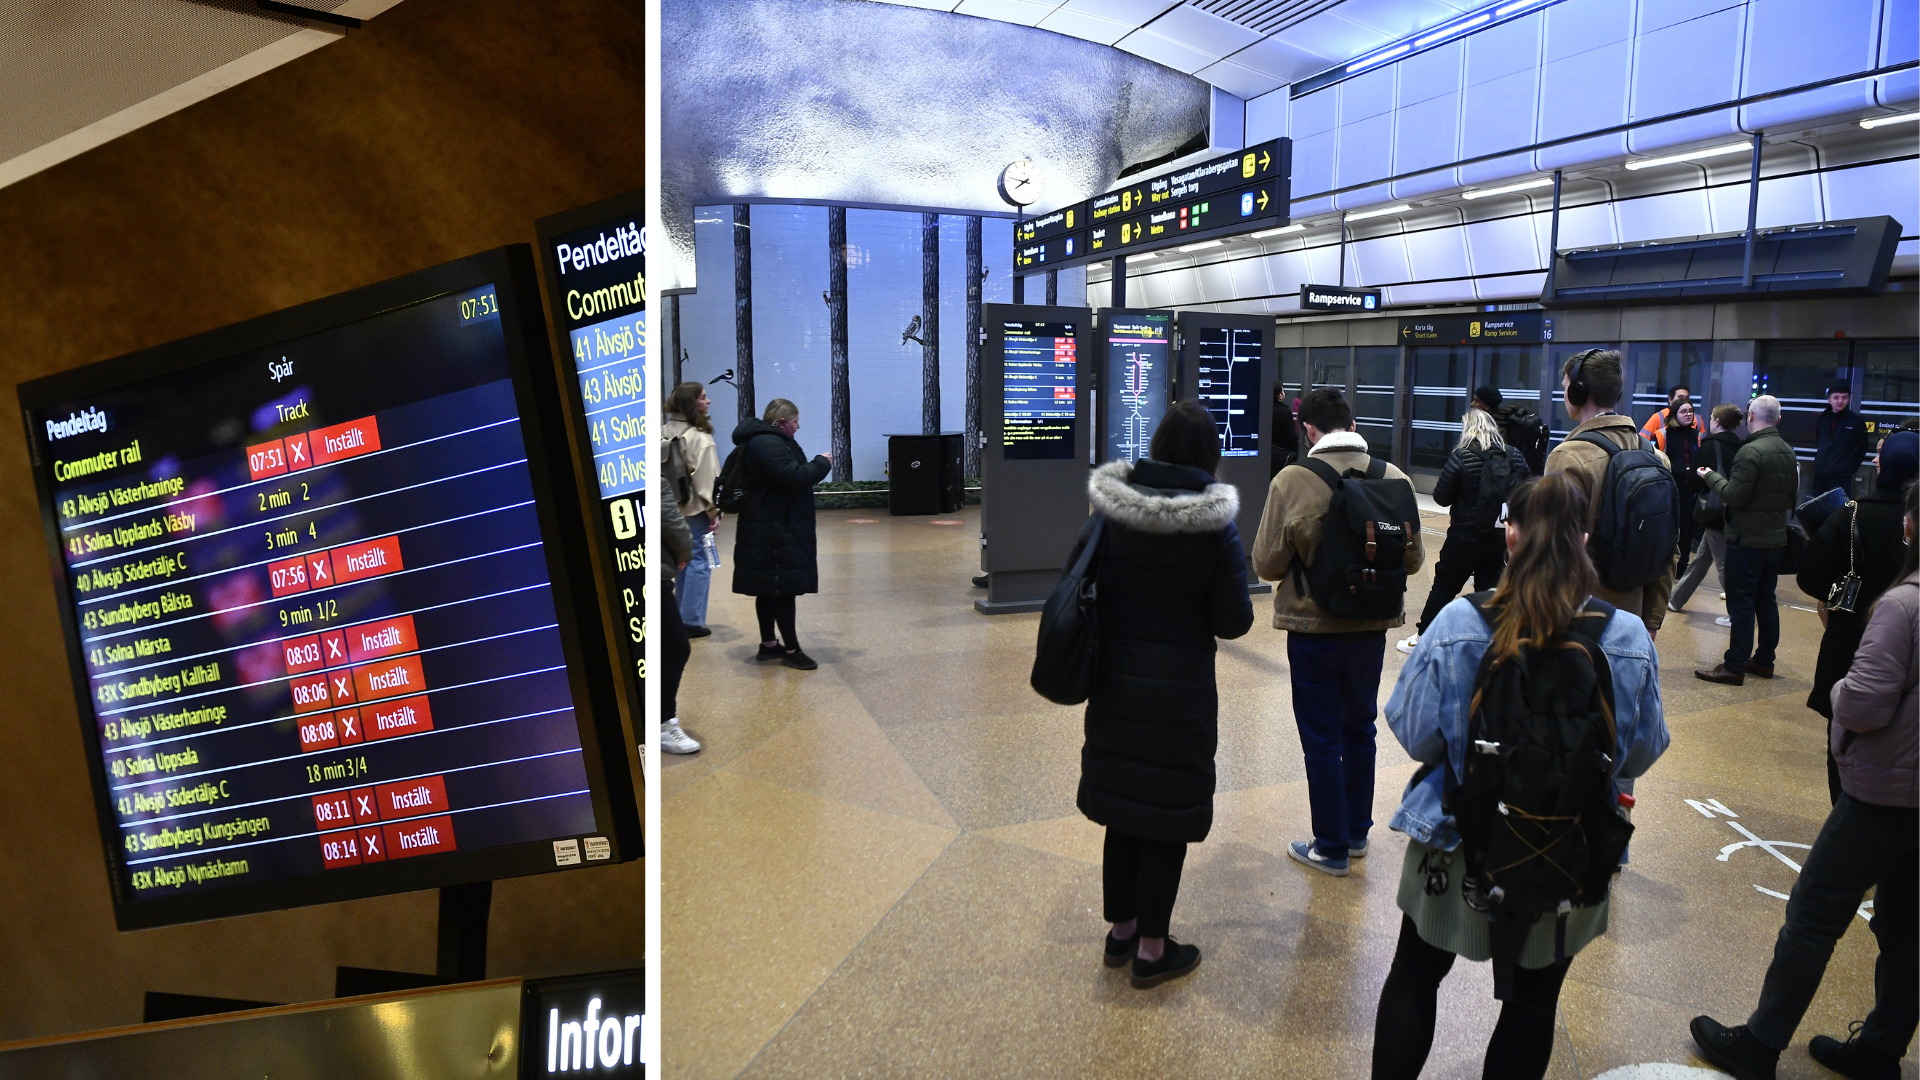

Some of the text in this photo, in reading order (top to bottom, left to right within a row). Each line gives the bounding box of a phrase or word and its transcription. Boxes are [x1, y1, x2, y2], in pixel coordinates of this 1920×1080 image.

[460, 293, 498, 320] 07:51
[567, 271, 646, 320] Commut
[1309, 291, 1362, 306] Rampservice
[1484, 321, 1514, 329] Rampservice
[1543, 329, 1552, 340] 16
[576, 335, 592, 363] 41
[594, 326, 634, 358] Älvsjö
[268, 356, 294, 382] Spår
[584, 368, 642, 404] 43 Älvsjö
[46, 406, 107, 441] Pendeltåg
[275, 399, 309, 423] Track
[592, 413, 646, 446] 41 Solna
[54, 439, 142, 482] Commuter rail
[250, 428, 365, 472] 07:51 X Inställt
[600, 460, 618, 488] 40
[62, 476, 184, 519] 43 Älvsjö Västerhaninge
[258, 483, 310, 512] 2 min 2
[69, 511, 196, 556] 41 Solna Upplands Väsby
[265, 521, 317, 550] 3 min 4
[76, 552, 187, 593] 40 Älvsjö Södertälje C
[272, 547, 387, 589] 07:56 X Inställt
[615, 543, 646, 572] Inst
[83, 592, 193, 630] 43 Sundbyberg Bålsta
[279, 599, 338, 627] 9 min 1/2
[90, 637, 172, 667] 41 Solna Märsta
[286, 626, 402, 666] 08:03 X Inställt
[97, 662, 221, 704] 43X Sundbyberg Kallhäll
[293, 666, 410, 705] 08:06 X Inställt
[104, 705, 227, 741] 43 Älvsjö Västerhaninge
[301, 706, 417, 744] 08:08 X Inställt
[111, 746, 199, 779] 40 Solna Uppsala
[306, 756, 368, 784] 18 min 3/4
[118, 780, 230, 816] 41 Älvsjö Södertälje C
[316, 786, 432, 822] 08:11 X Inställt
[125, 816, 270, 853] 43 Sundbyberg Kungsängen
[323, 826, 440, 861] 08:14 X Inställt
[131, 858, 249, 890] 43X Älvsjö Nynäshamn
